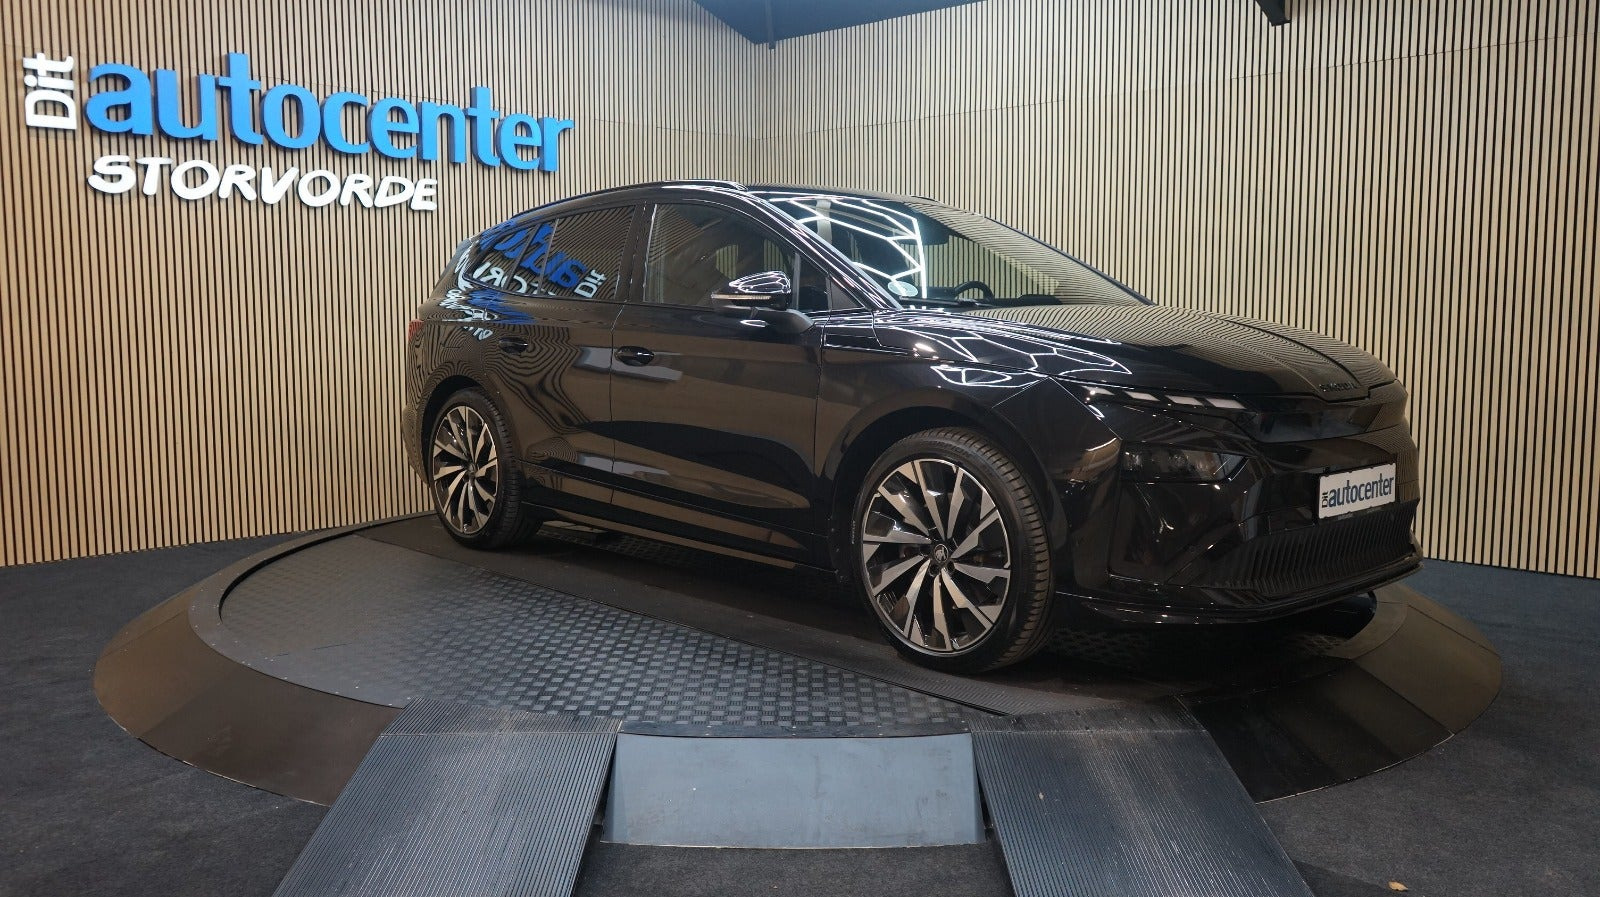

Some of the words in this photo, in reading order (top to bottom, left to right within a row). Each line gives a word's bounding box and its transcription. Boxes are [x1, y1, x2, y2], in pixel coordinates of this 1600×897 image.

[23, 52, 77, 130] Dit
[86, 52, 574, 172] autocenter
[87, 155, 438, 211] STORVORDE
[1321, 492, 1329, 508] Dit
[1328, 473, 1394, 507] autocenter
